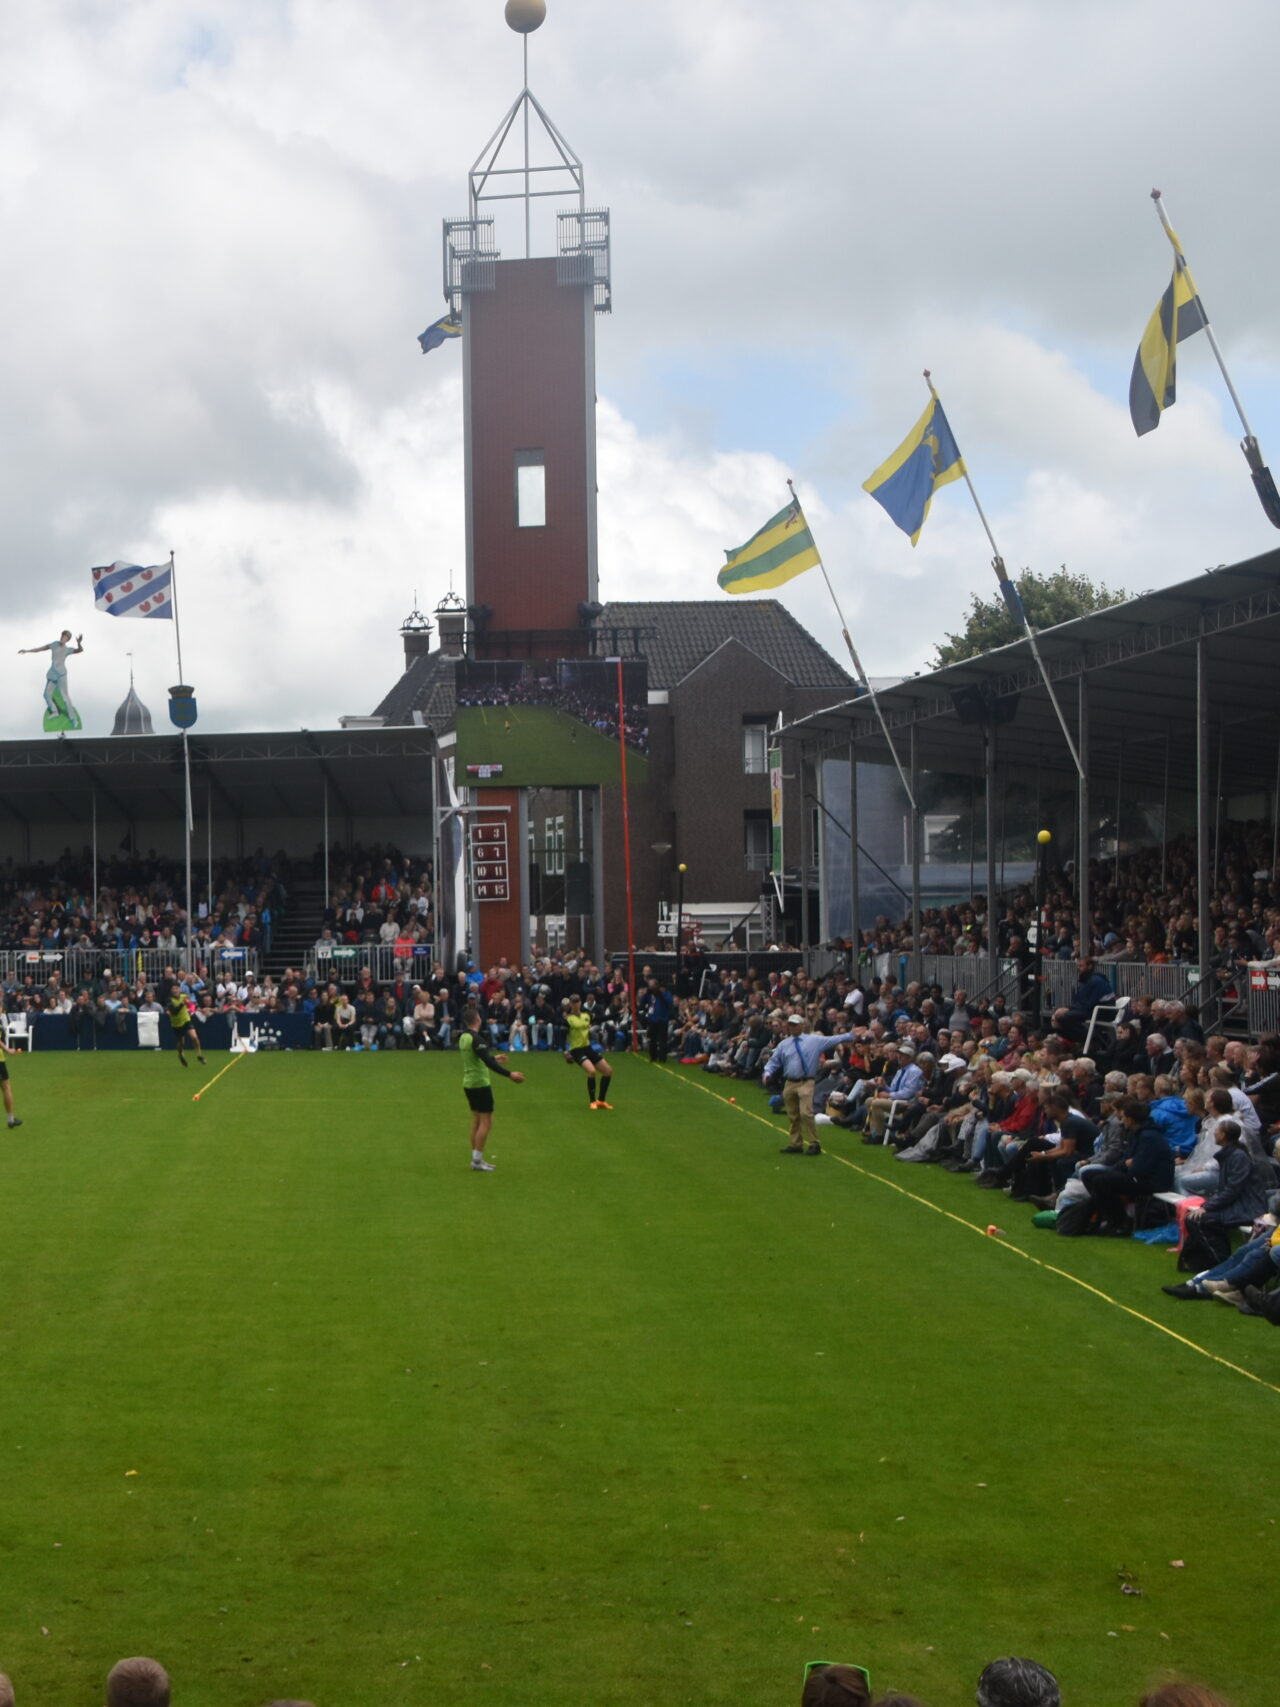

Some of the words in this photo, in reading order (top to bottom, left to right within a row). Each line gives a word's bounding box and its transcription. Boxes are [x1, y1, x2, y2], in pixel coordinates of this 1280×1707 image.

[477, 828, 483, 839] 1
[493, 828, 500, 839] 3
[477, 847, 484, 858] 6
[493, 847, 500, 858] 7
[477, 866, 487, 877] 10
[494, 866, 503, 877] 11
[477, 885, 487, 896] 14
[494, 884, 504, 896] 15
